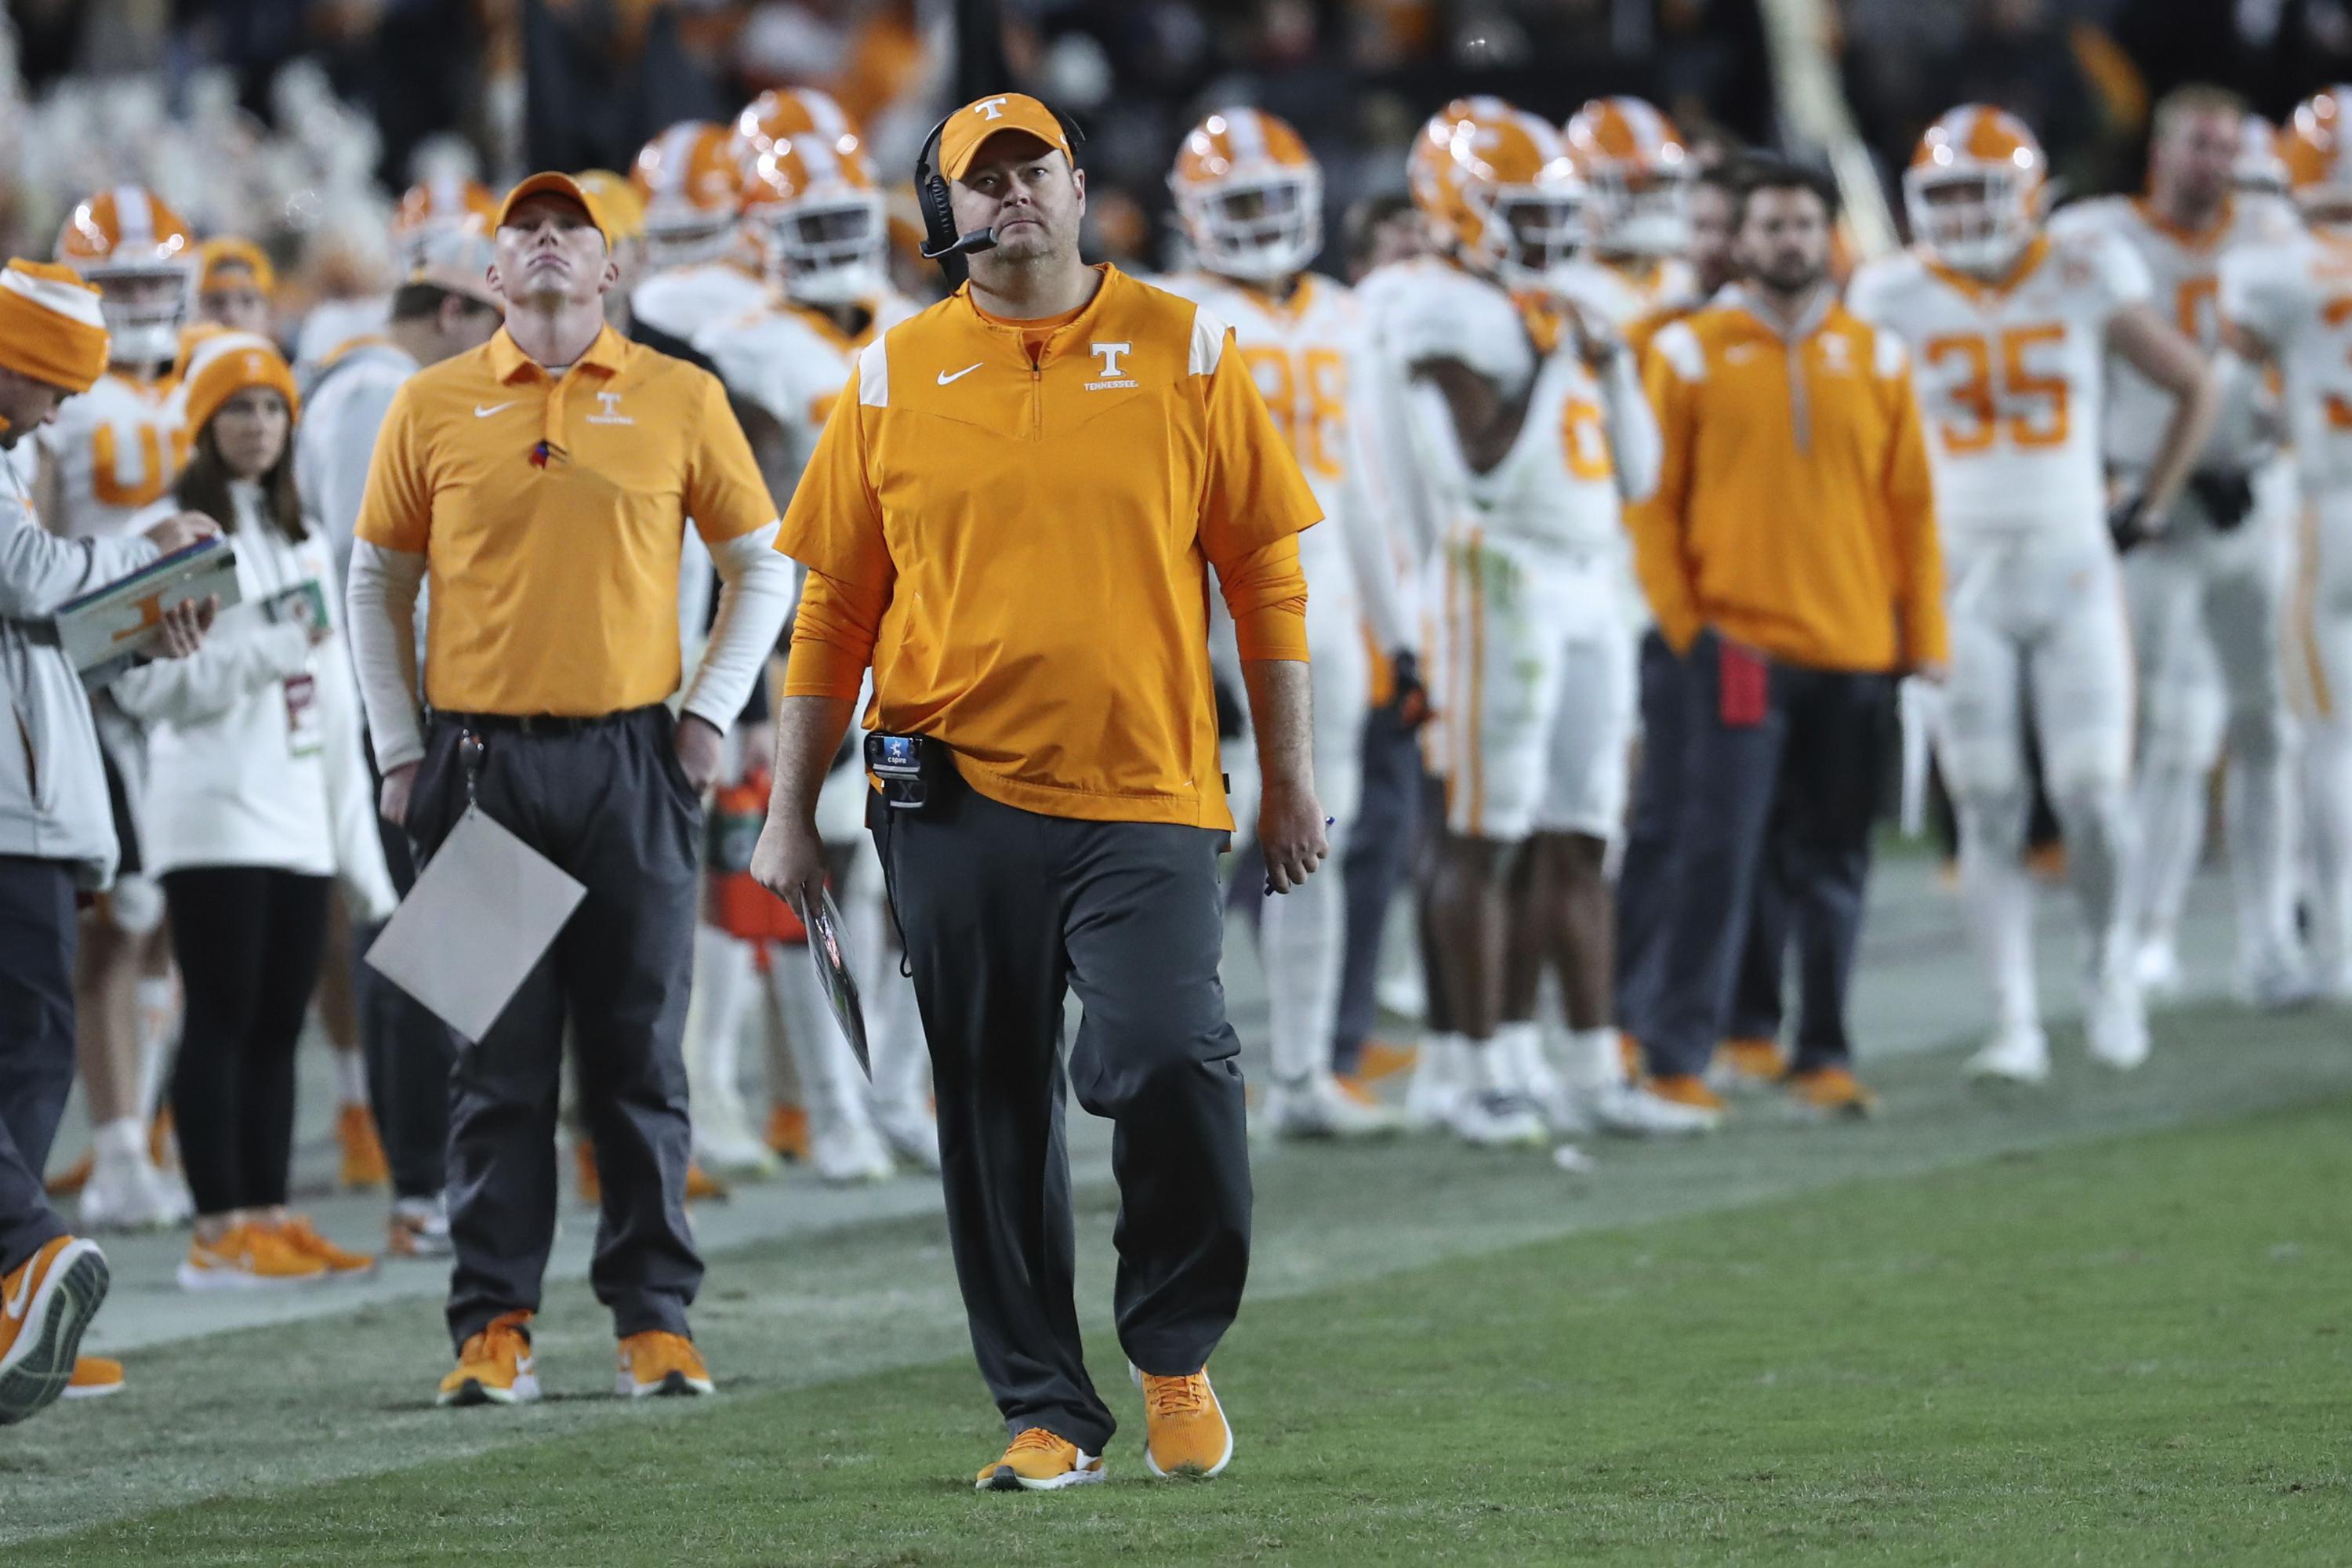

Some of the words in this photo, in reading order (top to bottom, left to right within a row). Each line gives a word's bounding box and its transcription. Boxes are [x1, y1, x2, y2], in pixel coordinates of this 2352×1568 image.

[975, 97, 1007, 121] T
[1091, 342, 1131, 377] T
[1083, 380, 1137, 391] TENNESSEE
[1926, 323, 2068, 453] 35
[597, 391, 622, 416] T
